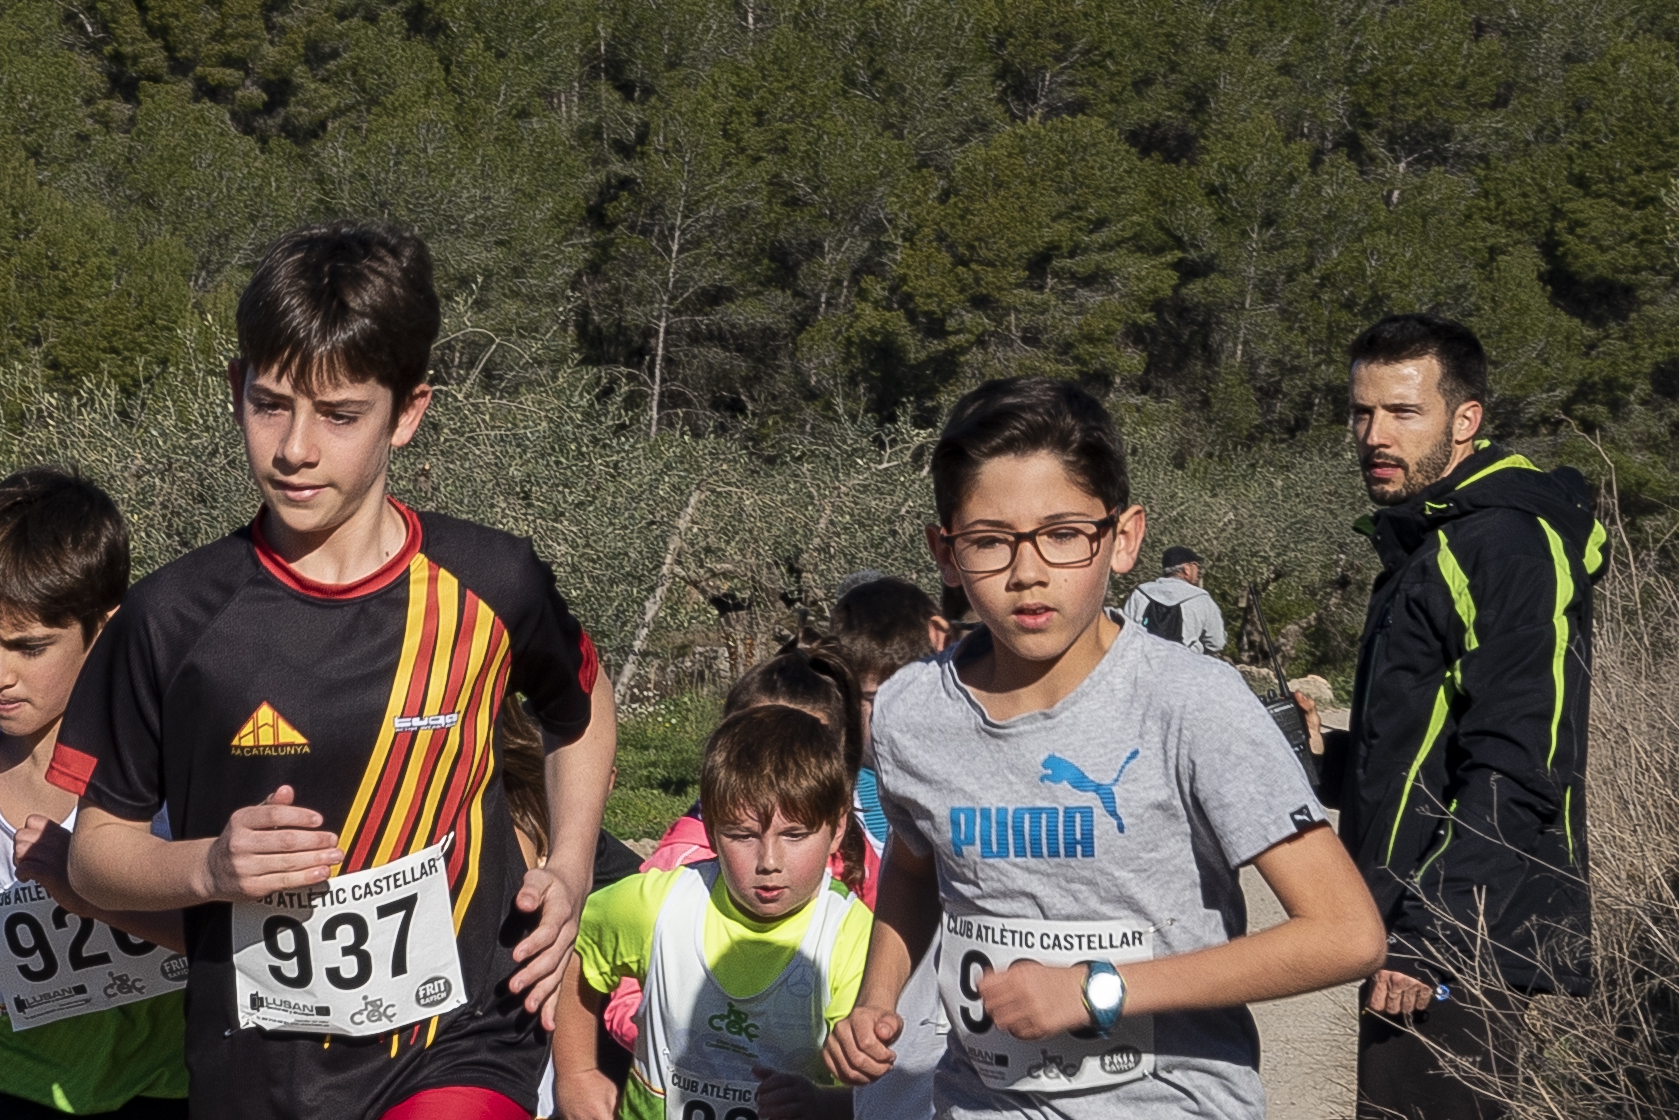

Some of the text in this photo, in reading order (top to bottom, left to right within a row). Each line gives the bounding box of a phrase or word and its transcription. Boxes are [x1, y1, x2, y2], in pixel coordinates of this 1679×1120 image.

[244, 745, 310, 757] CATALUNYA
[950, 806, 1095, 859] PUMA
[351, 857, 439, 900] CASTELLAR
[262, 892, 419, 991] 937
[947, 914, 1143, 951] CLUB ATLÈTIC CASTELLAR
[265, 996, 314, 1013] LUSAN
[419, 979, 446, 999] FRIT
[671, 1073, 698, 1094] CLUB
[700, 1083, 752, 1103] ATLÈTIC
